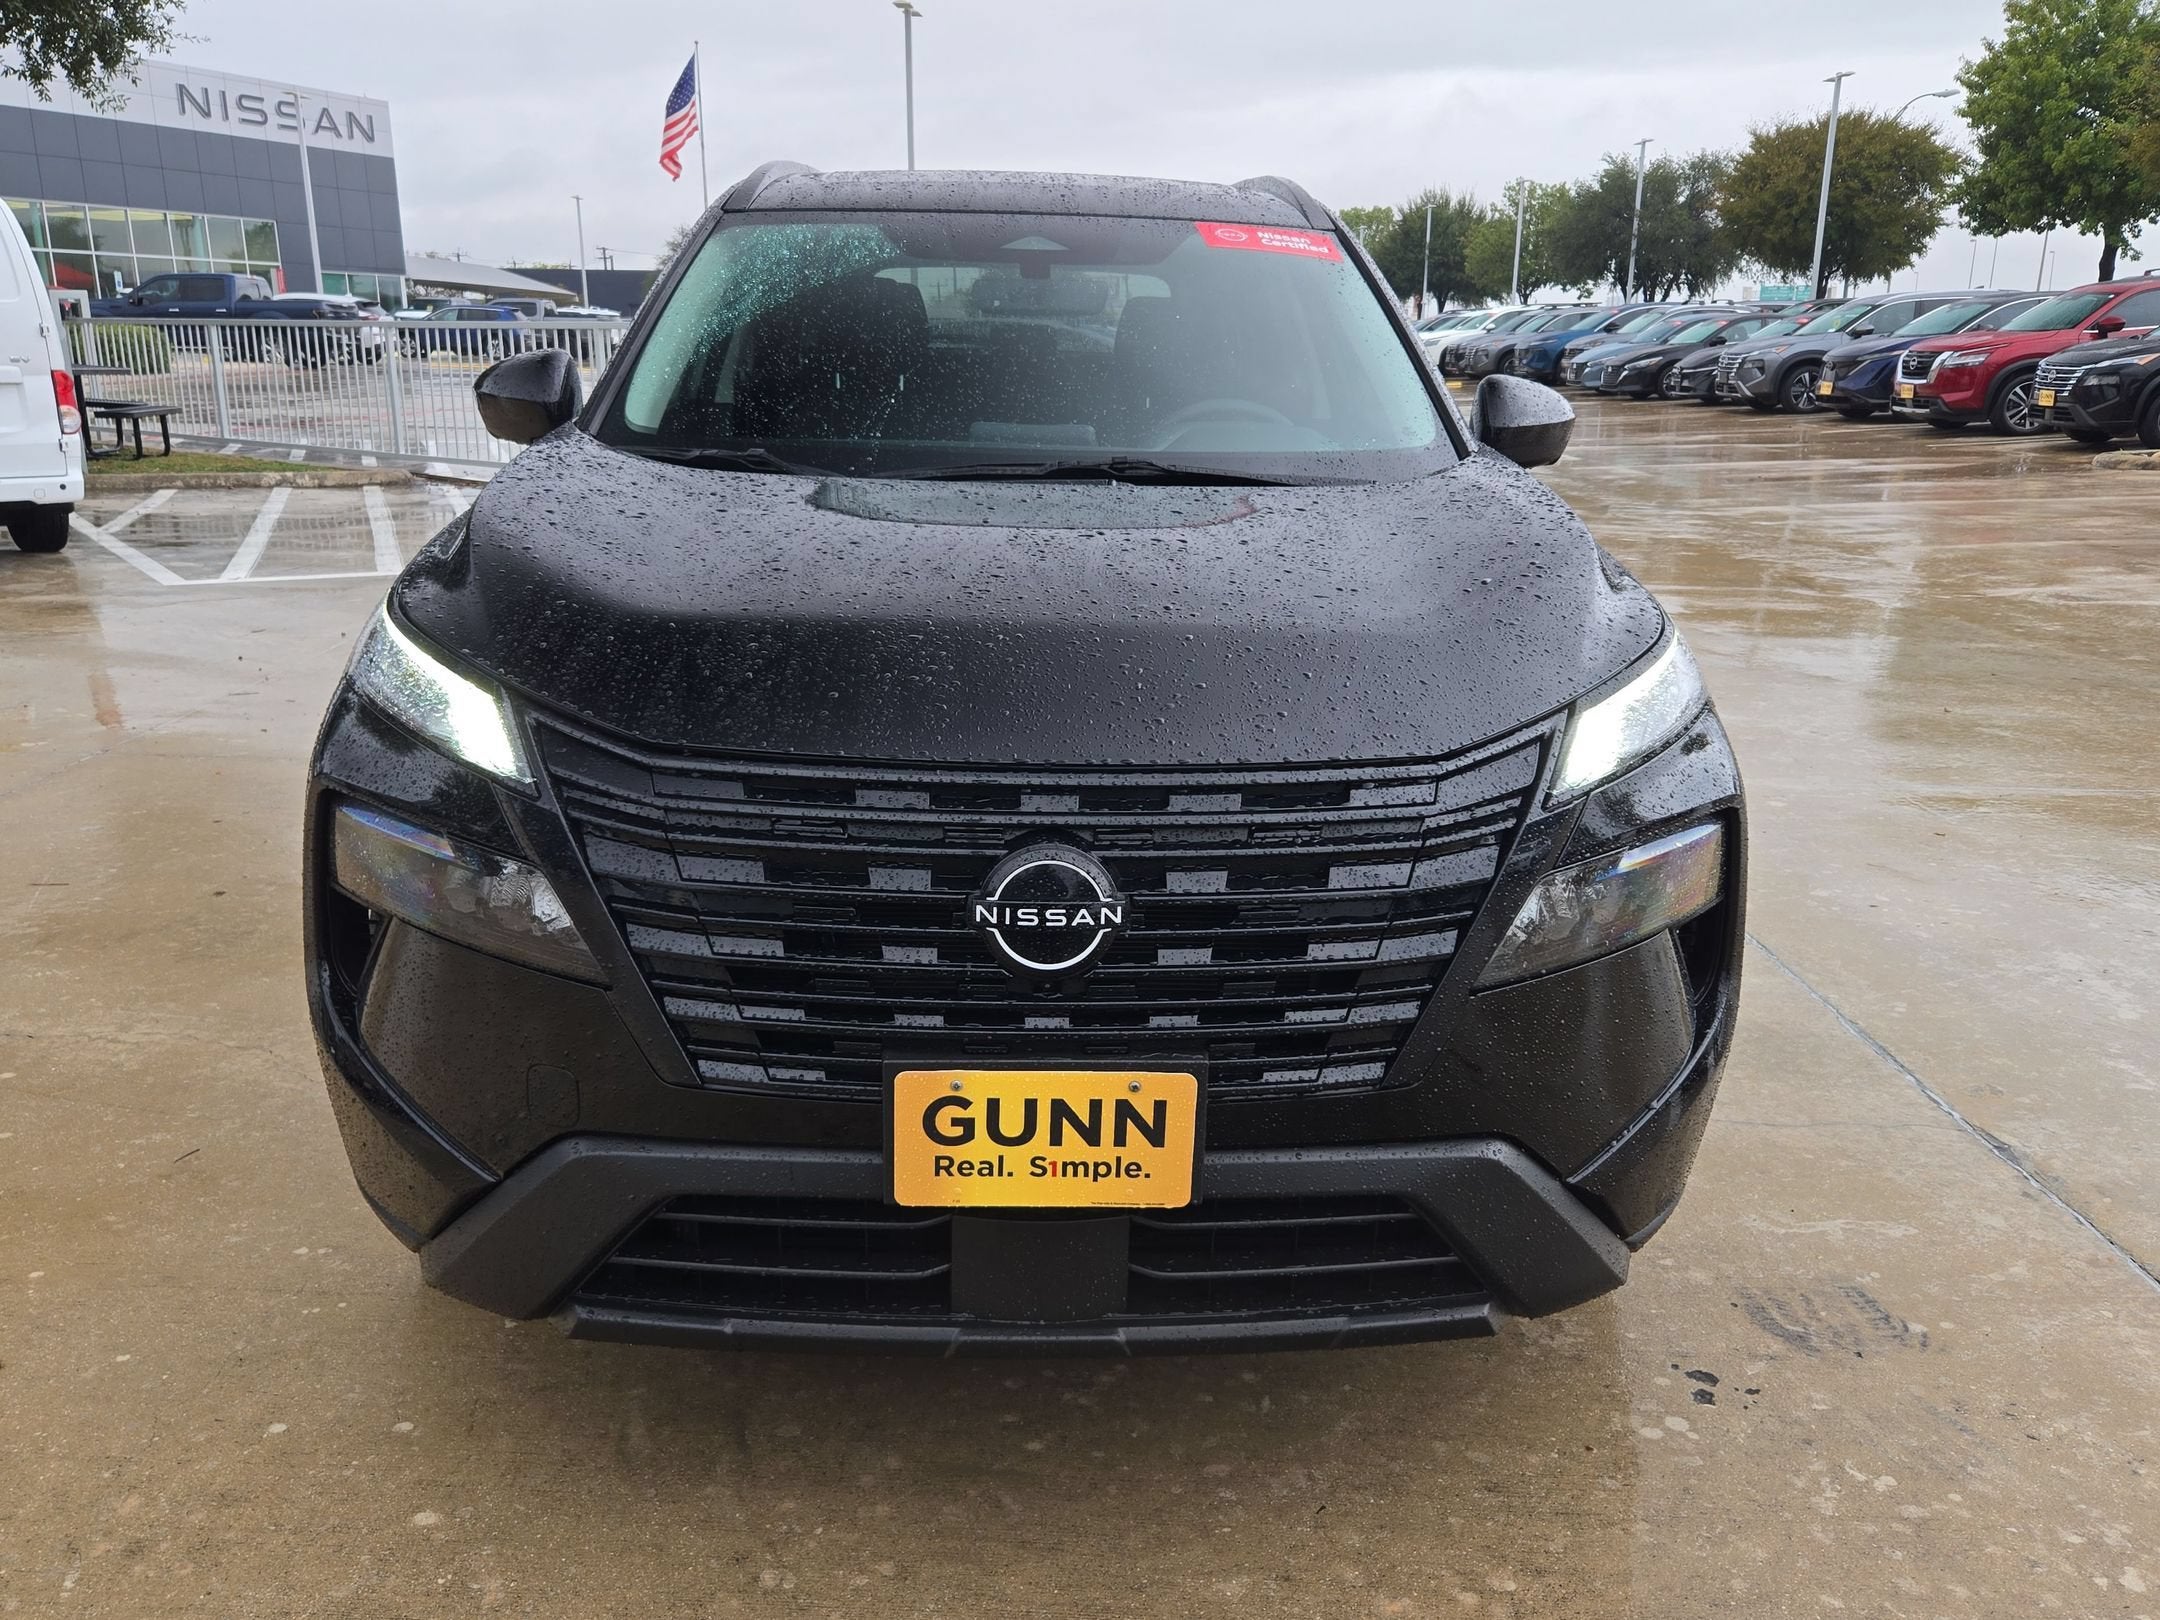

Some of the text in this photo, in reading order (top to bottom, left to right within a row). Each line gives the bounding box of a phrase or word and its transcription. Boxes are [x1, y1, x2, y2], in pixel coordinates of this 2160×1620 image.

[176, 83, 375, 143] NISSAN
[1257, 231, 1312, 245] Nissan
[1261, 238, 1329, 254] Certified
[975, 905, 1122, 926] NISSAN
[922, 1095, 1168, 1148] GUNN
[934, 1155, 1151, 1182] Real. S1mple.
